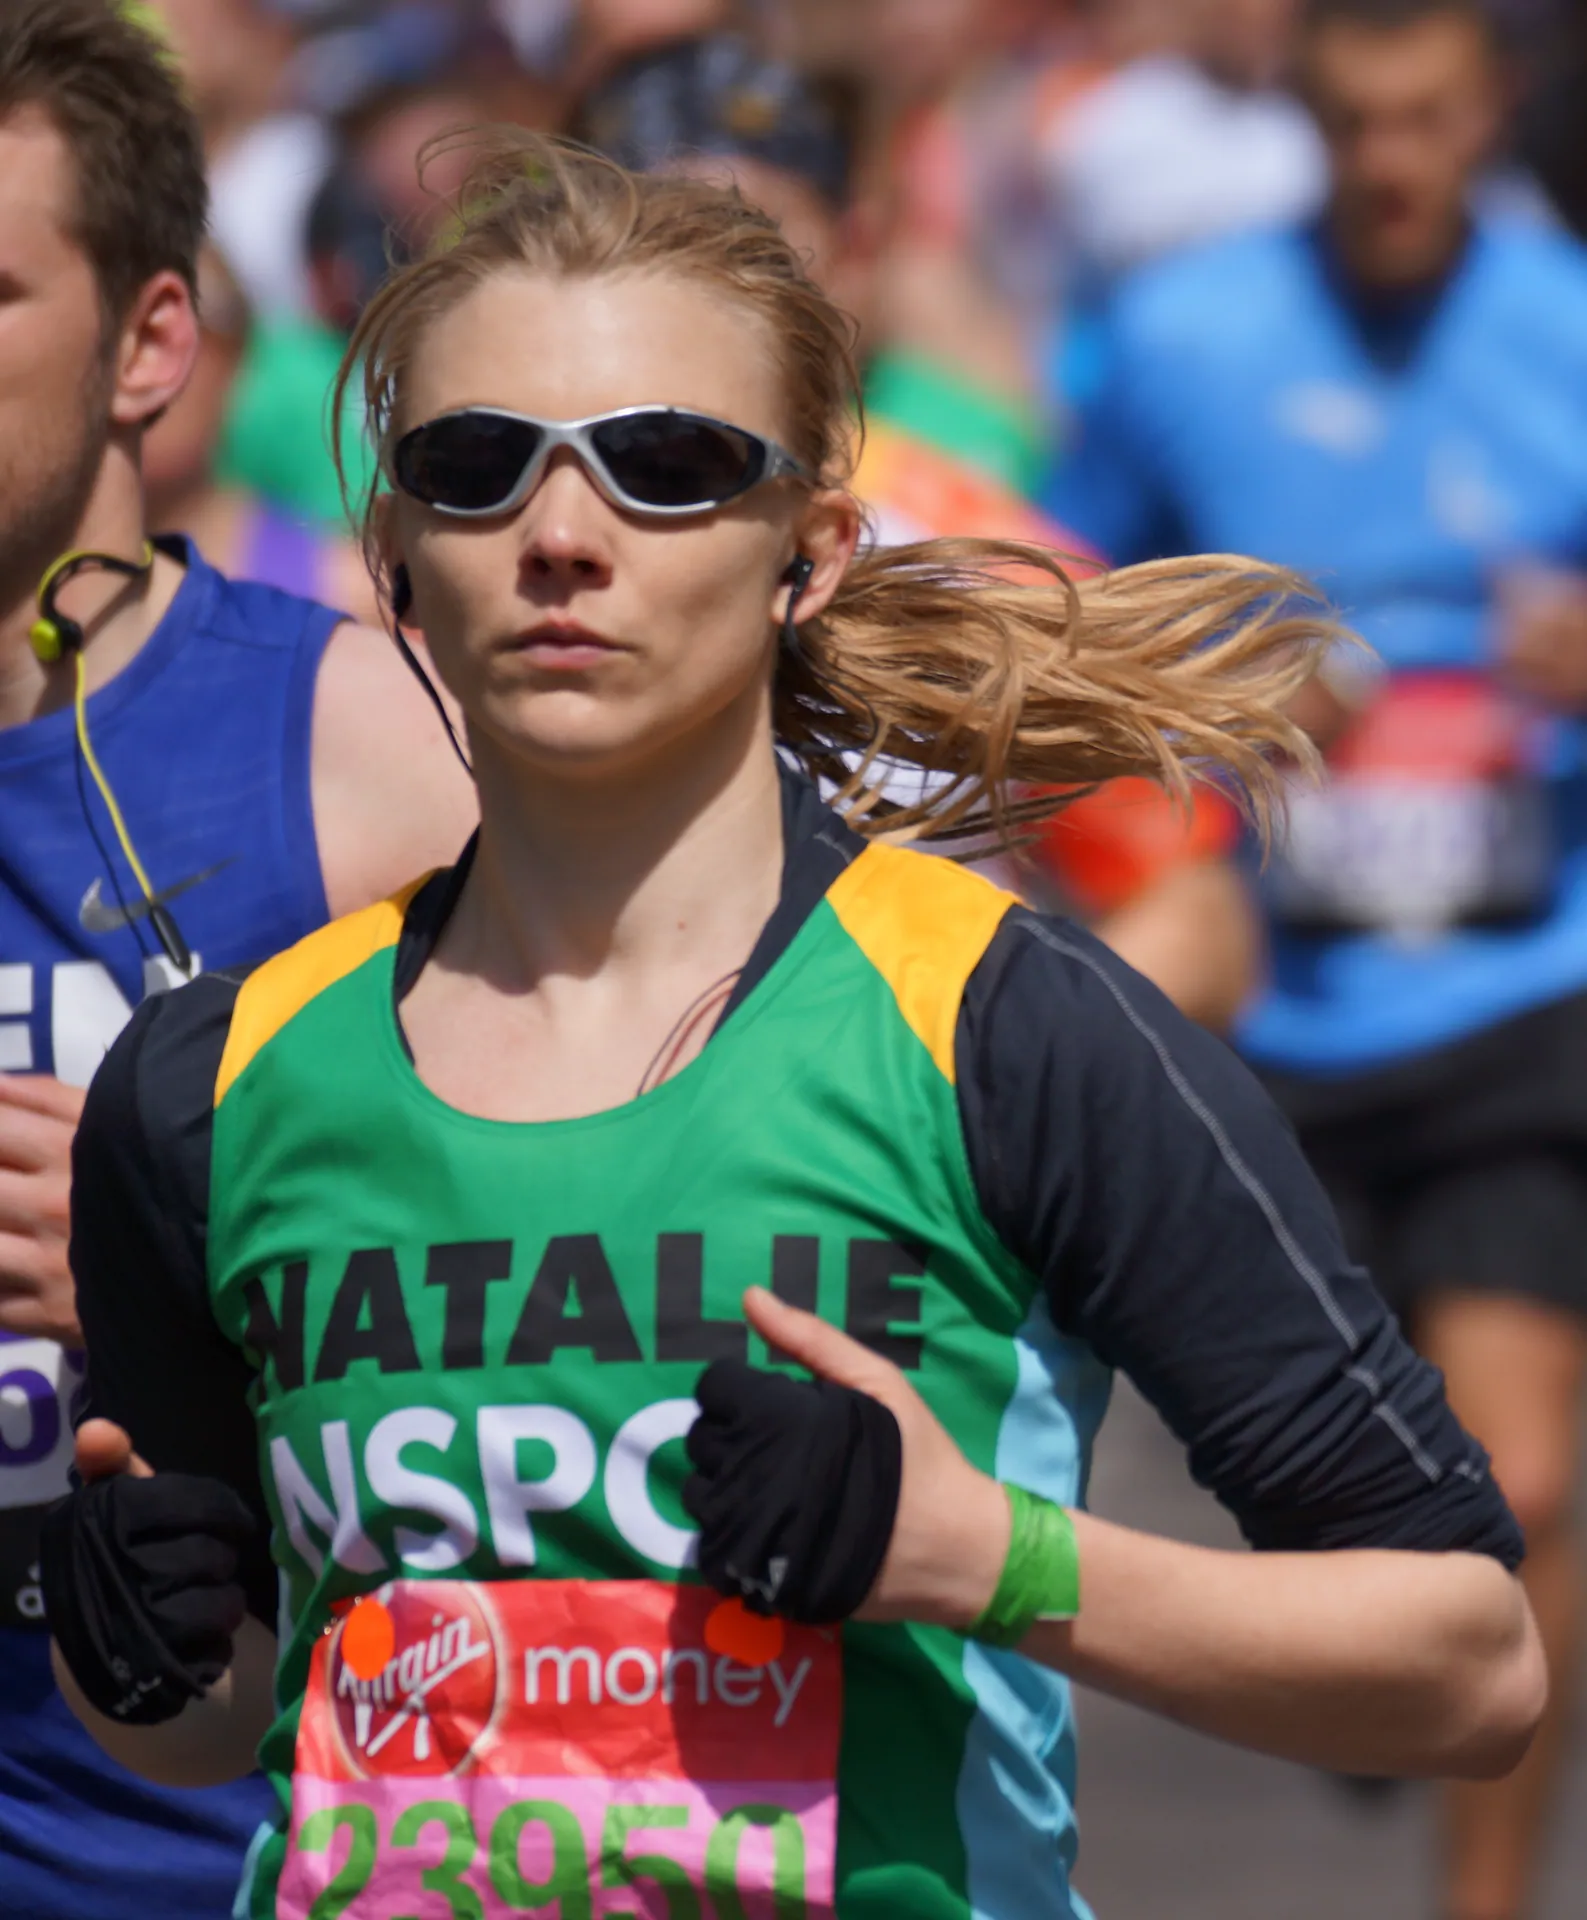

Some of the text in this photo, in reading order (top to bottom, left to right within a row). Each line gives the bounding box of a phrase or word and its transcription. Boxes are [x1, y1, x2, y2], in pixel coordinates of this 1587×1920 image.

[241, 1231, 930, 1396] NATALIE
[524, 1646, 812, 1728] money
[297, 1799, 807, 1920] 23950
